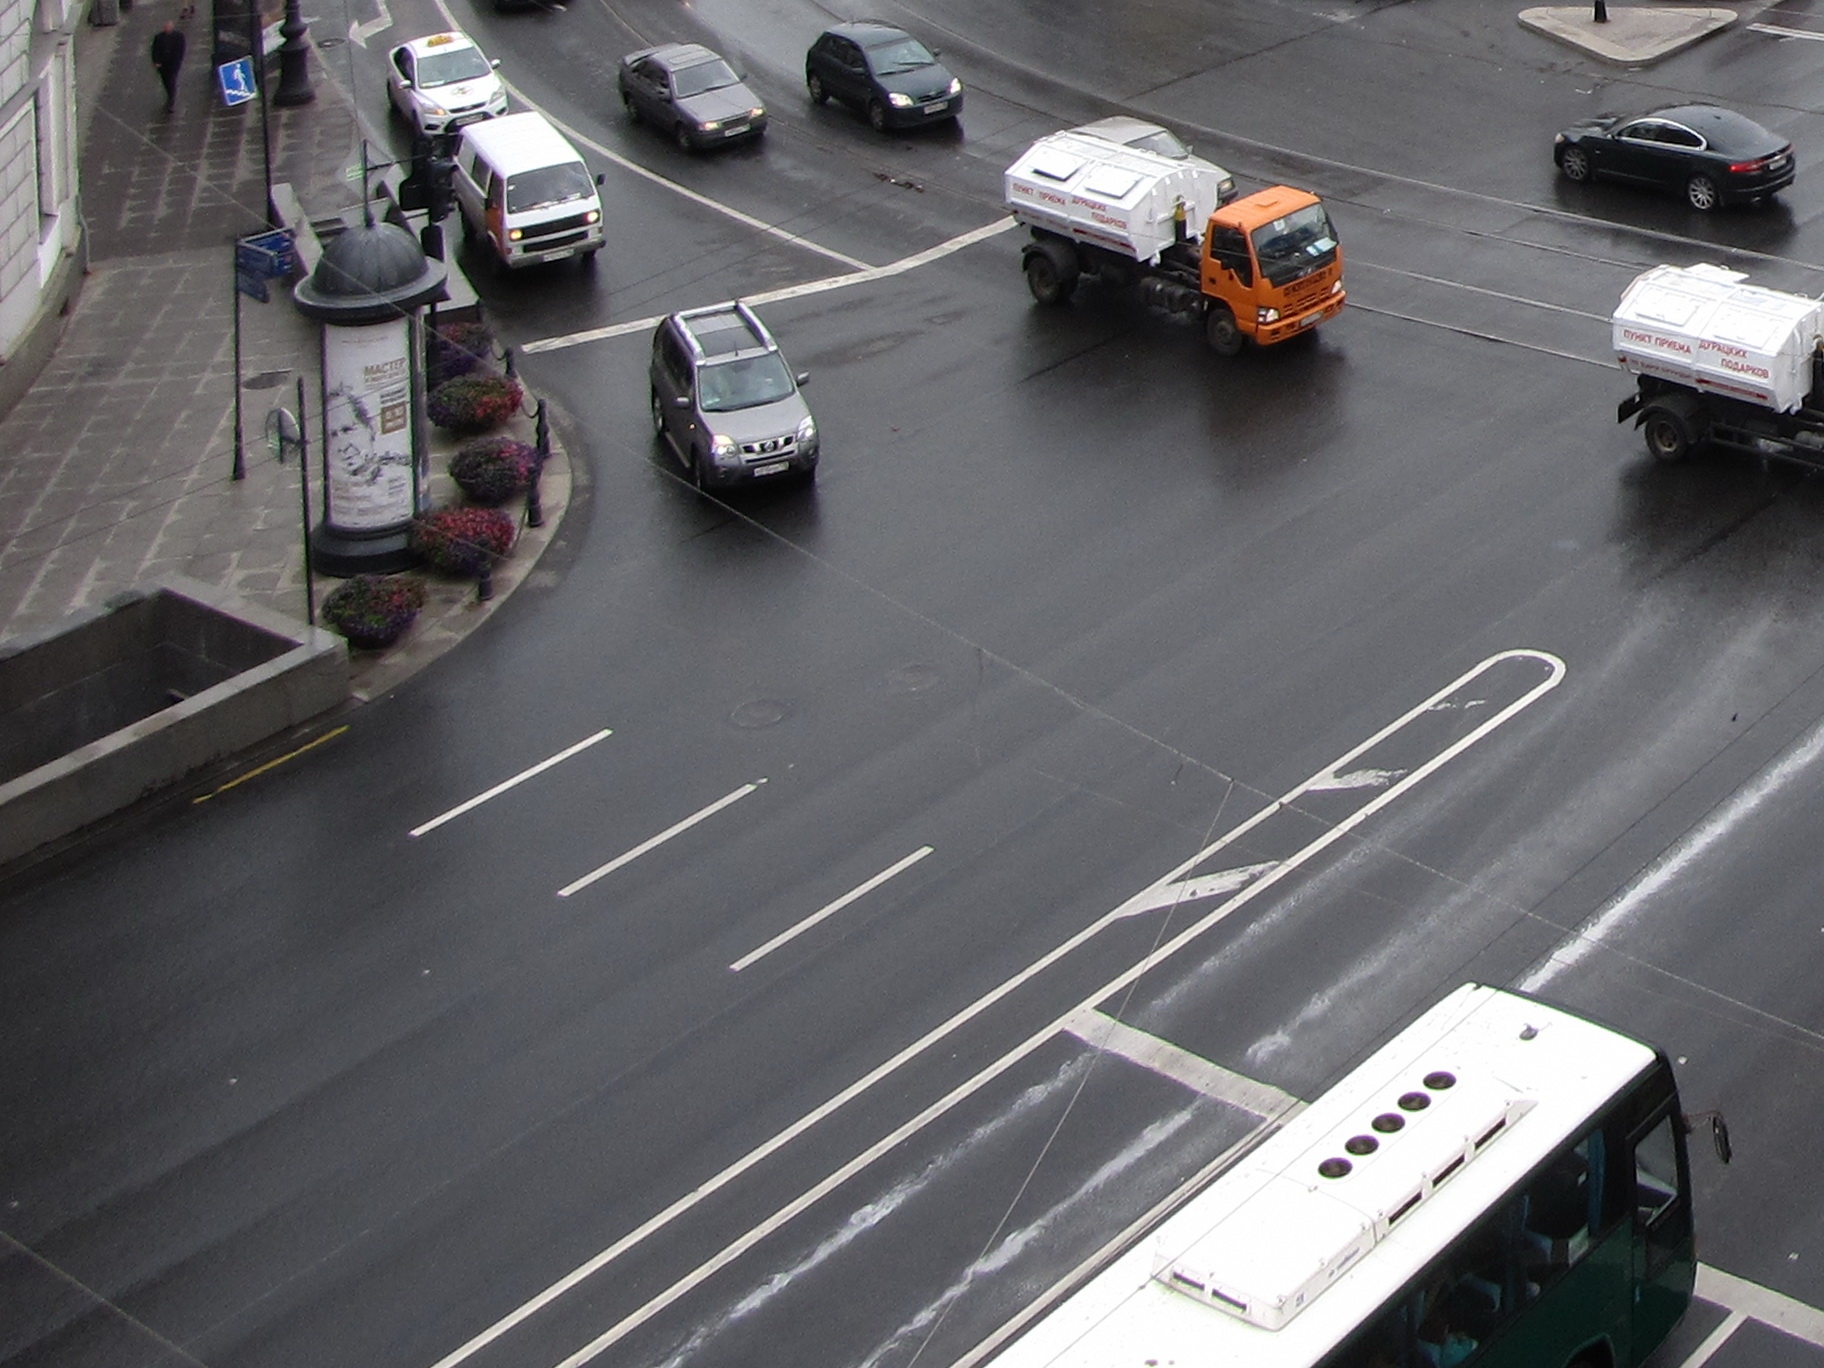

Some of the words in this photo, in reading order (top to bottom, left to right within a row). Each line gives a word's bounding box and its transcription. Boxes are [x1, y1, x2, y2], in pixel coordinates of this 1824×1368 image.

[1624, 329, 1652, 344] ПУНКТ
[1699, 340, 1748, 359] ДУРАЦКИХ
[1721, 358, 1769, 379] ПОДАРКОВ
